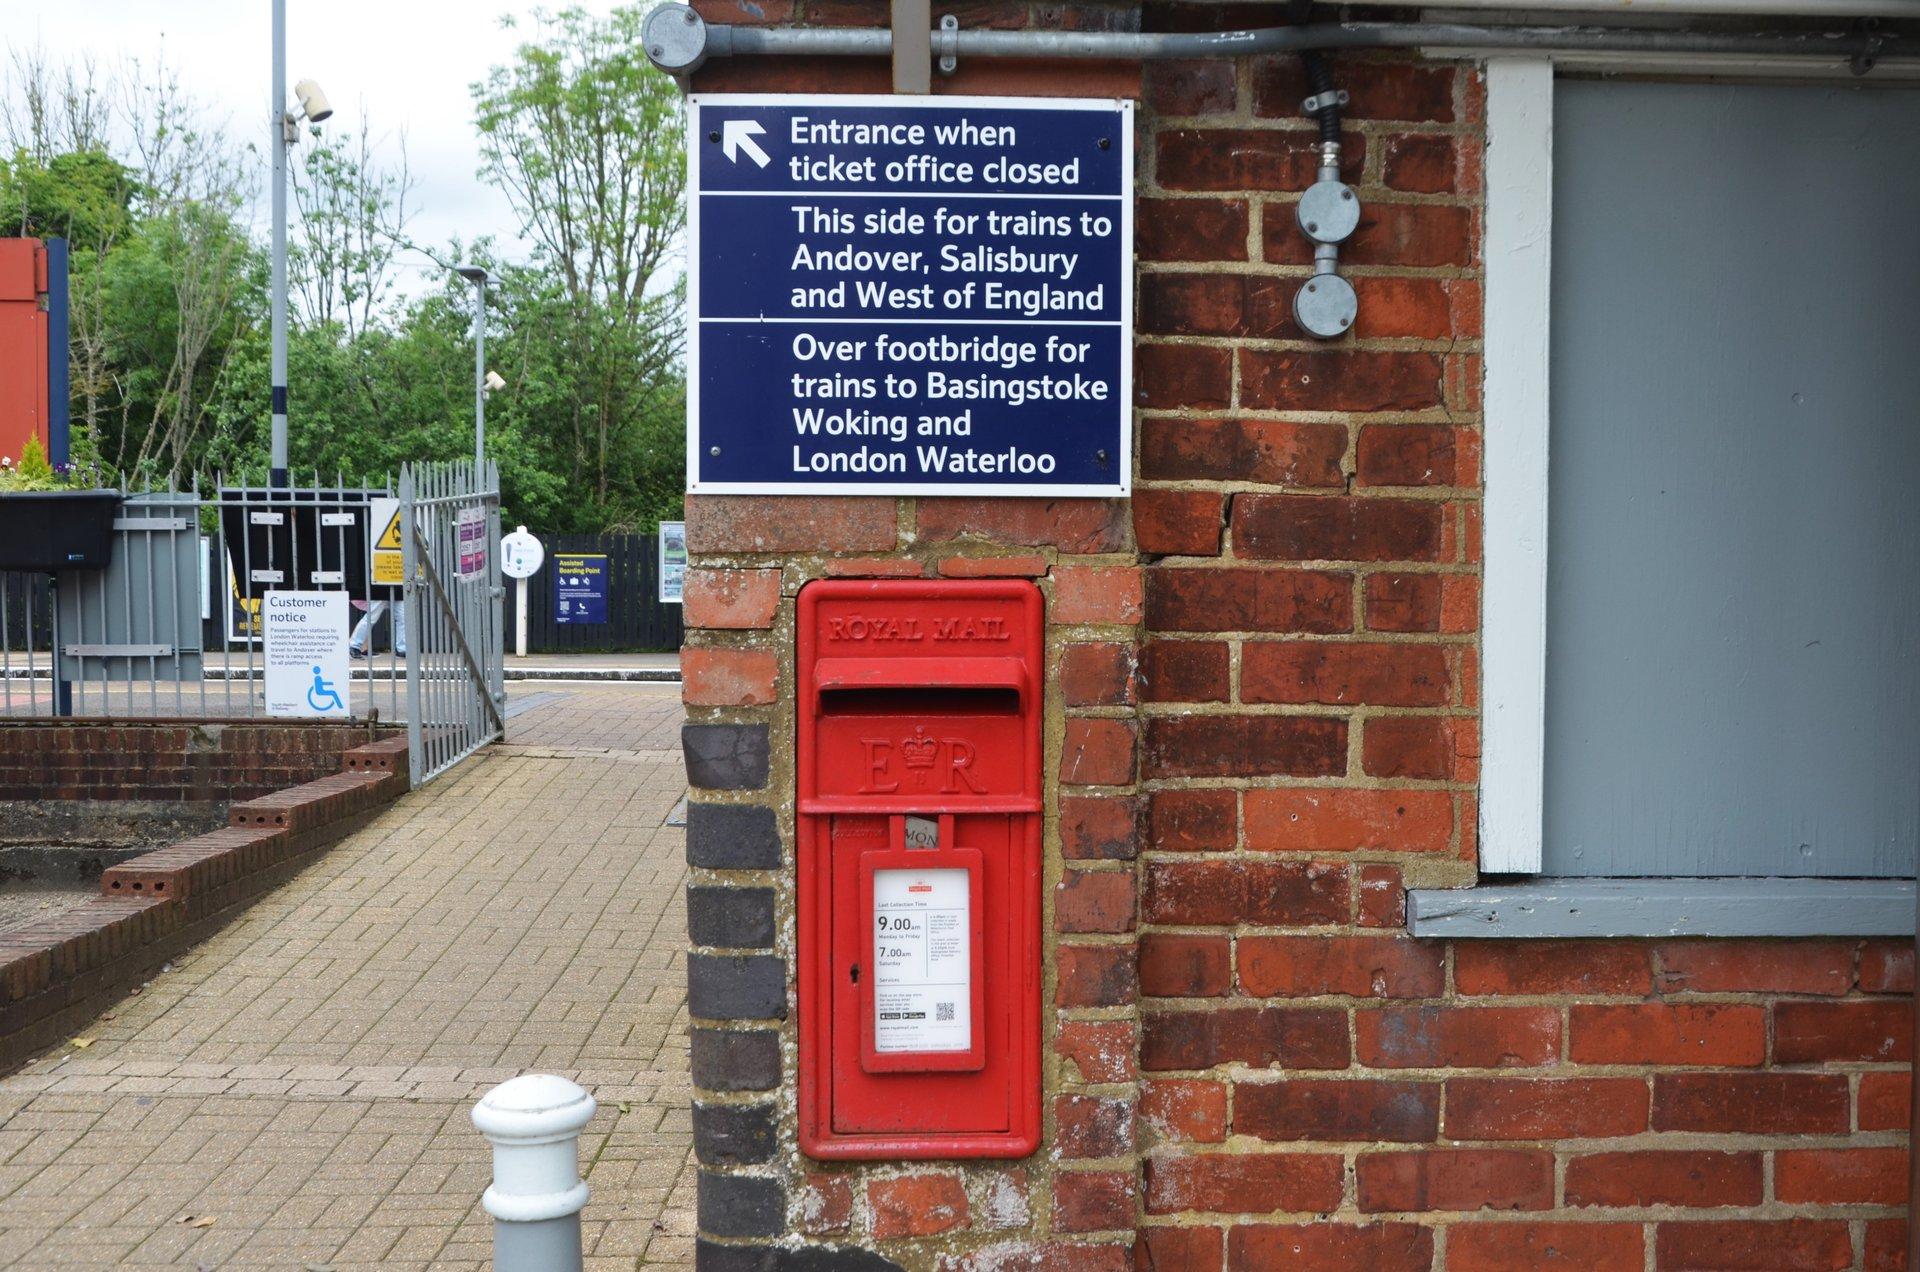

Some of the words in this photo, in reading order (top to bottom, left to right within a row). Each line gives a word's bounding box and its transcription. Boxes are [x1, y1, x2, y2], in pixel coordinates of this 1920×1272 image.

[792, 117, 924, 145] Entrance
[934, 119, 1015, 145] when
[789, 154, 876, 181] ticket
[886, 155, 973, 182] office
[983, 156, 1078, 184] closed
[792, 207, 855, 233] This
[864, 207, 924, 234] side
[934, 208, 979, 234] for
[987, 211, 1071, 236] trains
[1080, 212, 1111, 236] to
[791, 244, 928, 274] Andover,
[941, 245, 1078, 279] Salisbury
[791, 281, 844, 308] and
[856, 282, 934, 308] West
[944, 282, 975, 308] of
[986, 283, 1103, 316] England
[793, 333, 866, 361] Over
[875, 334, 1036, 368] footbridge
[1046, 336, 1090, 362] for
[791, 373, 876, 398] trains
[885, 374, 917, 398] to
[928, 372, 1107, 405] Basingstoke
[793, 408, 907, 442] Woking
[917, 409, 970, 435] and
[794, 446, 905, 472] London
[917, 446, 1055, 473] Waterloo
[270, 596, 327, 607] Customer
[270, 612, 306, 622] notice
[828, 618, 924, 641] ROYAL
[933, 618, 1010, 642] MAIL
[858, 738, 900, 794] E
[940, 738, 988, 794] R
[906, 829, 936, 846] MON
[878, 916, 920, 930] 9.00am
[879, 947, 911, 957] 7.00am
